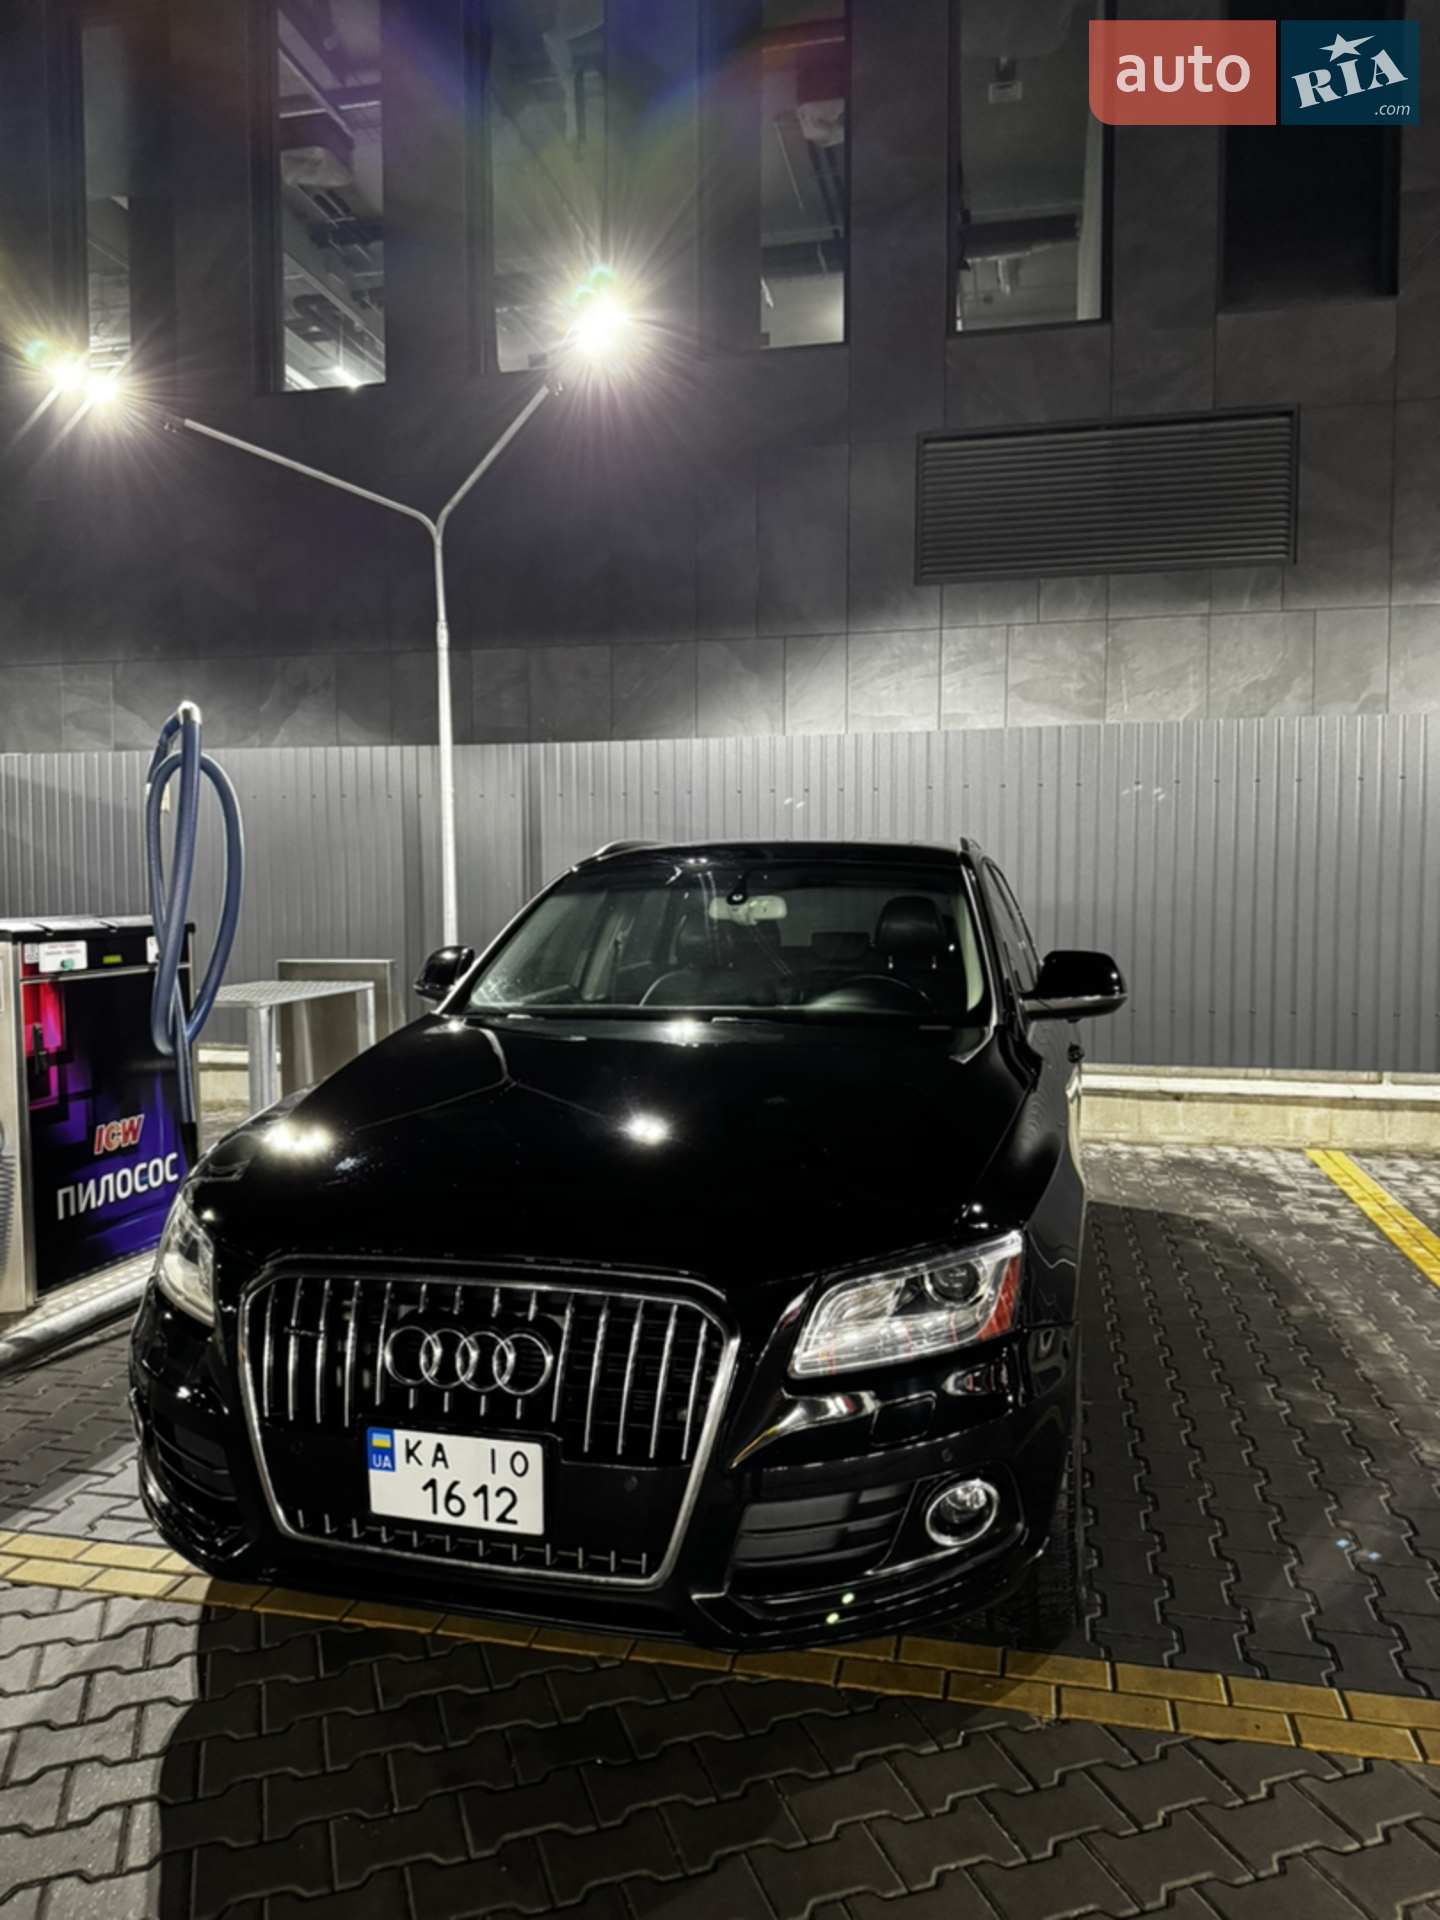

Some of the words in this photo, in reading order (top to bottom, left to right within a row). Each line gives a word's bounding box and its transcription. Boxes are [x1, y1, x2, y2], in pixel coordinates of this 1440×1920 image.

[94, 1115, 144, 1154] ICW
[57, 1153, 178, 1220] ПИЛОСОС
[372, 1454, 392, 1468] UA
[405, 1438, 449, 1469] KA
[421, 1478, 518, 1525] 1612
